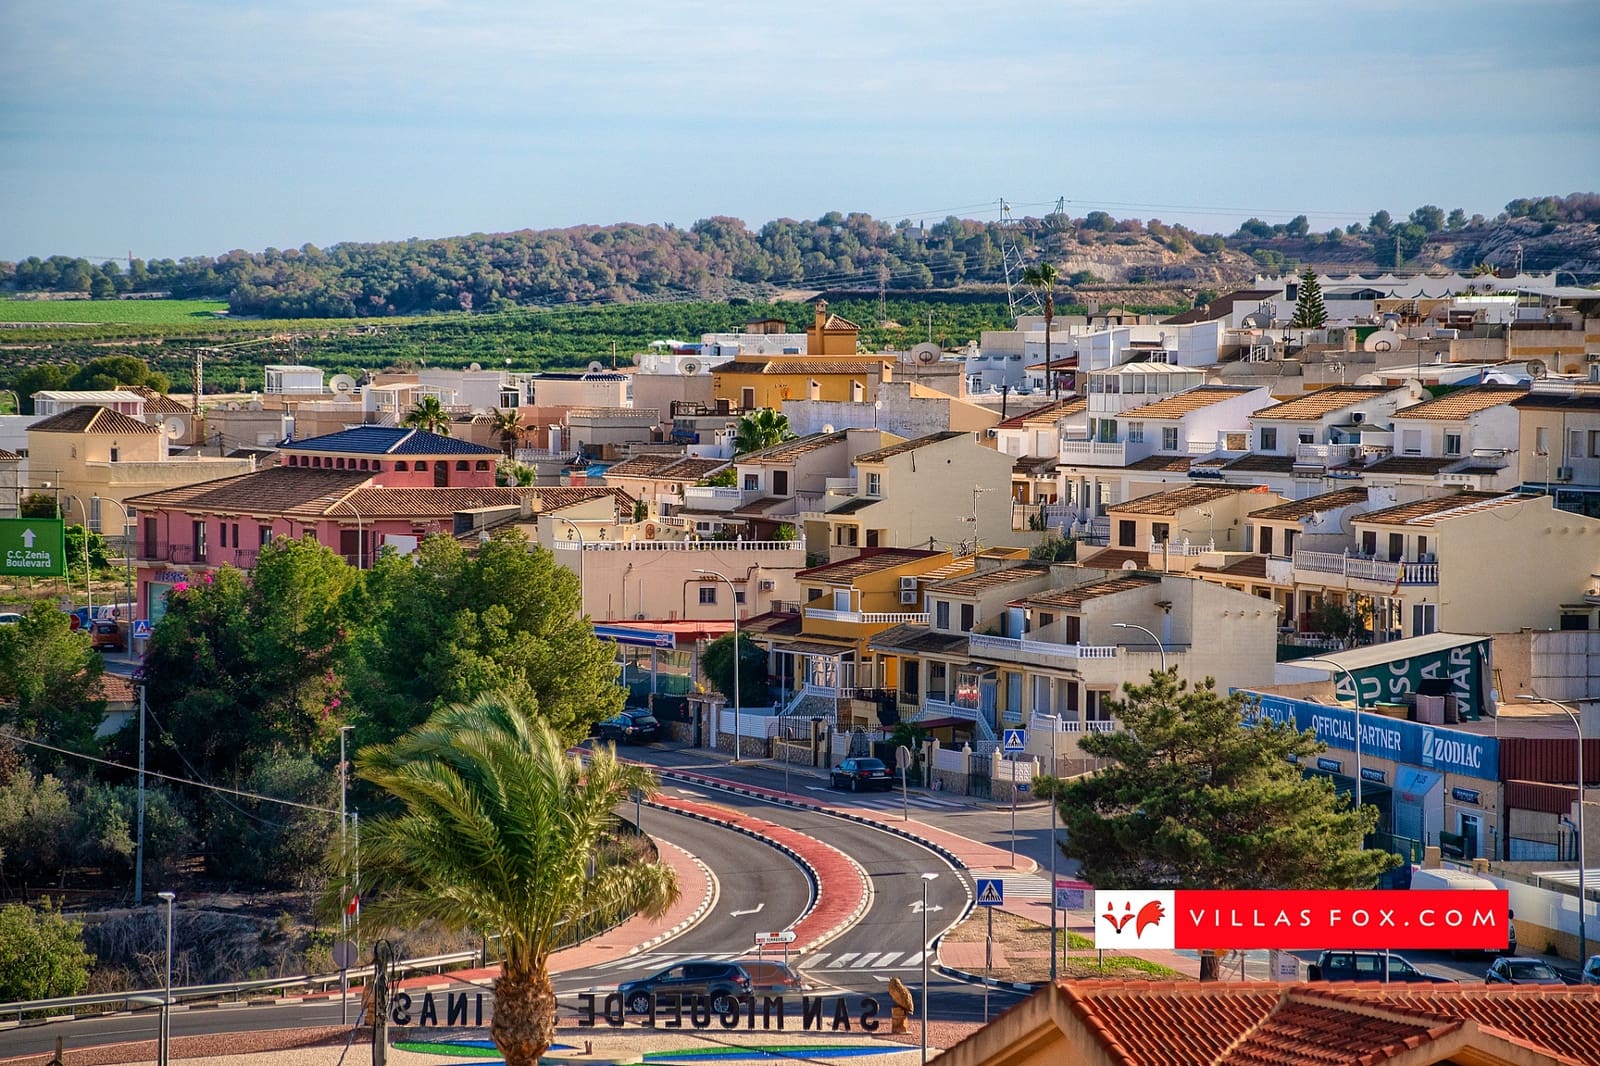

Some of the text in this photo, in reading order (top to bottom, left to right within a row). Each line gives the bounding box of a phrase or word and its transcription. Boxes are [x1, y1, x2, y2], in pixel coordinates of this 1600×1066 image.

[6, 558, 51, 568] Boulevard
[7, 551, 50, 559] C.C. Zenia
[1311, 714, 1401, 751] OFFICIAL PARTNER
[1434, 738, 1481, 769] ZODIAC
